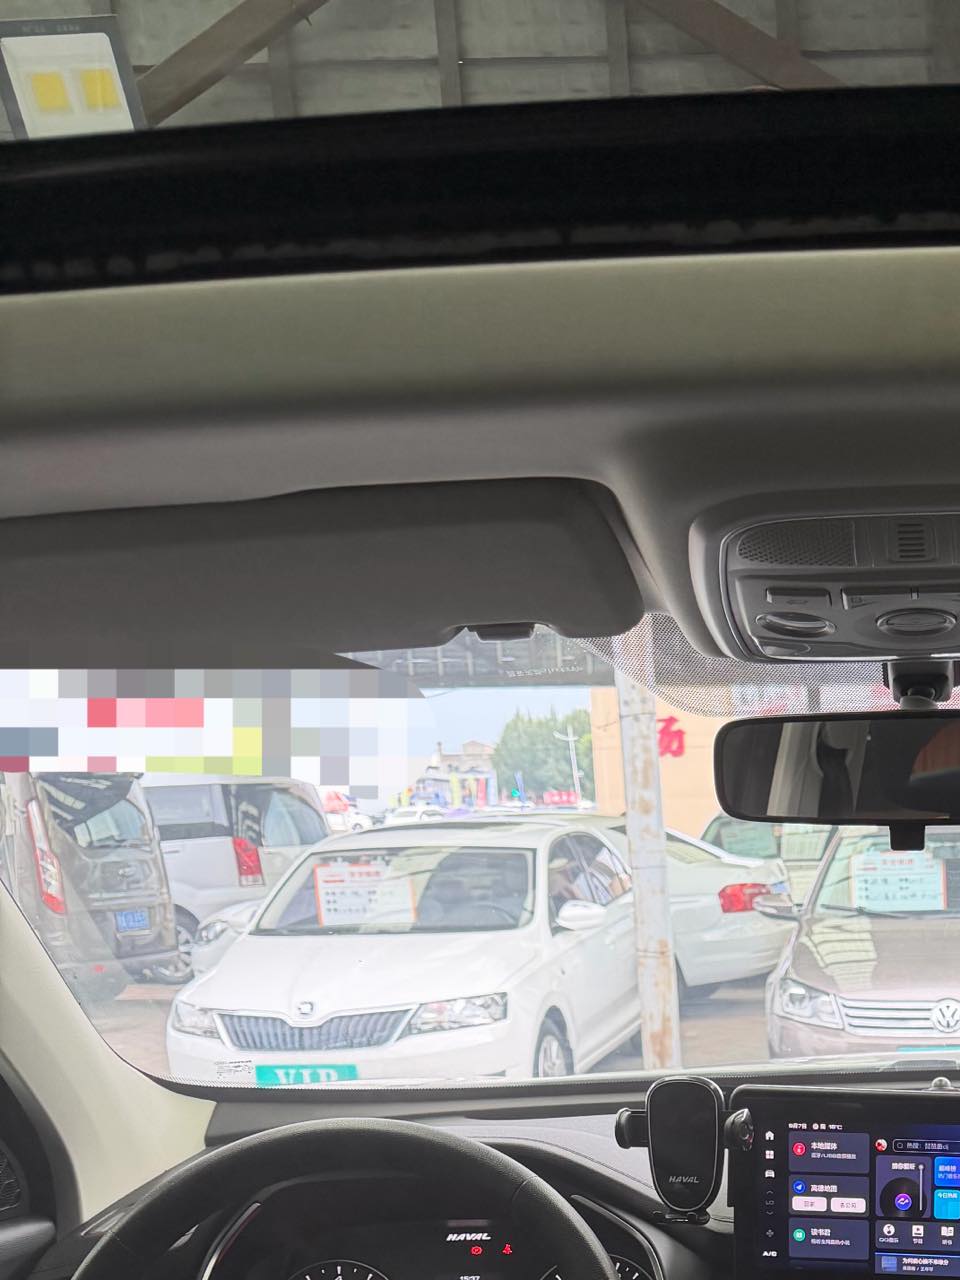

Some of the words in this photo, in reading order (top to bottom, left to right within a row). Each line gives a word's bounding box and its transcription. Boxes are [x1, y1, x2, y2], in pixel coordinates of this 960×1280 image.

[275, 1069, 338, 1084] VIP
[811, 1141, 838, 1151] 本地媒体
[668, 1175, 700, 1184] HAVAL
[810, 1184, 838, 1193] 高德地图
[446, 1232, 492, 1242] HAVAL
[762, 1250, 778, 1258] A/C
